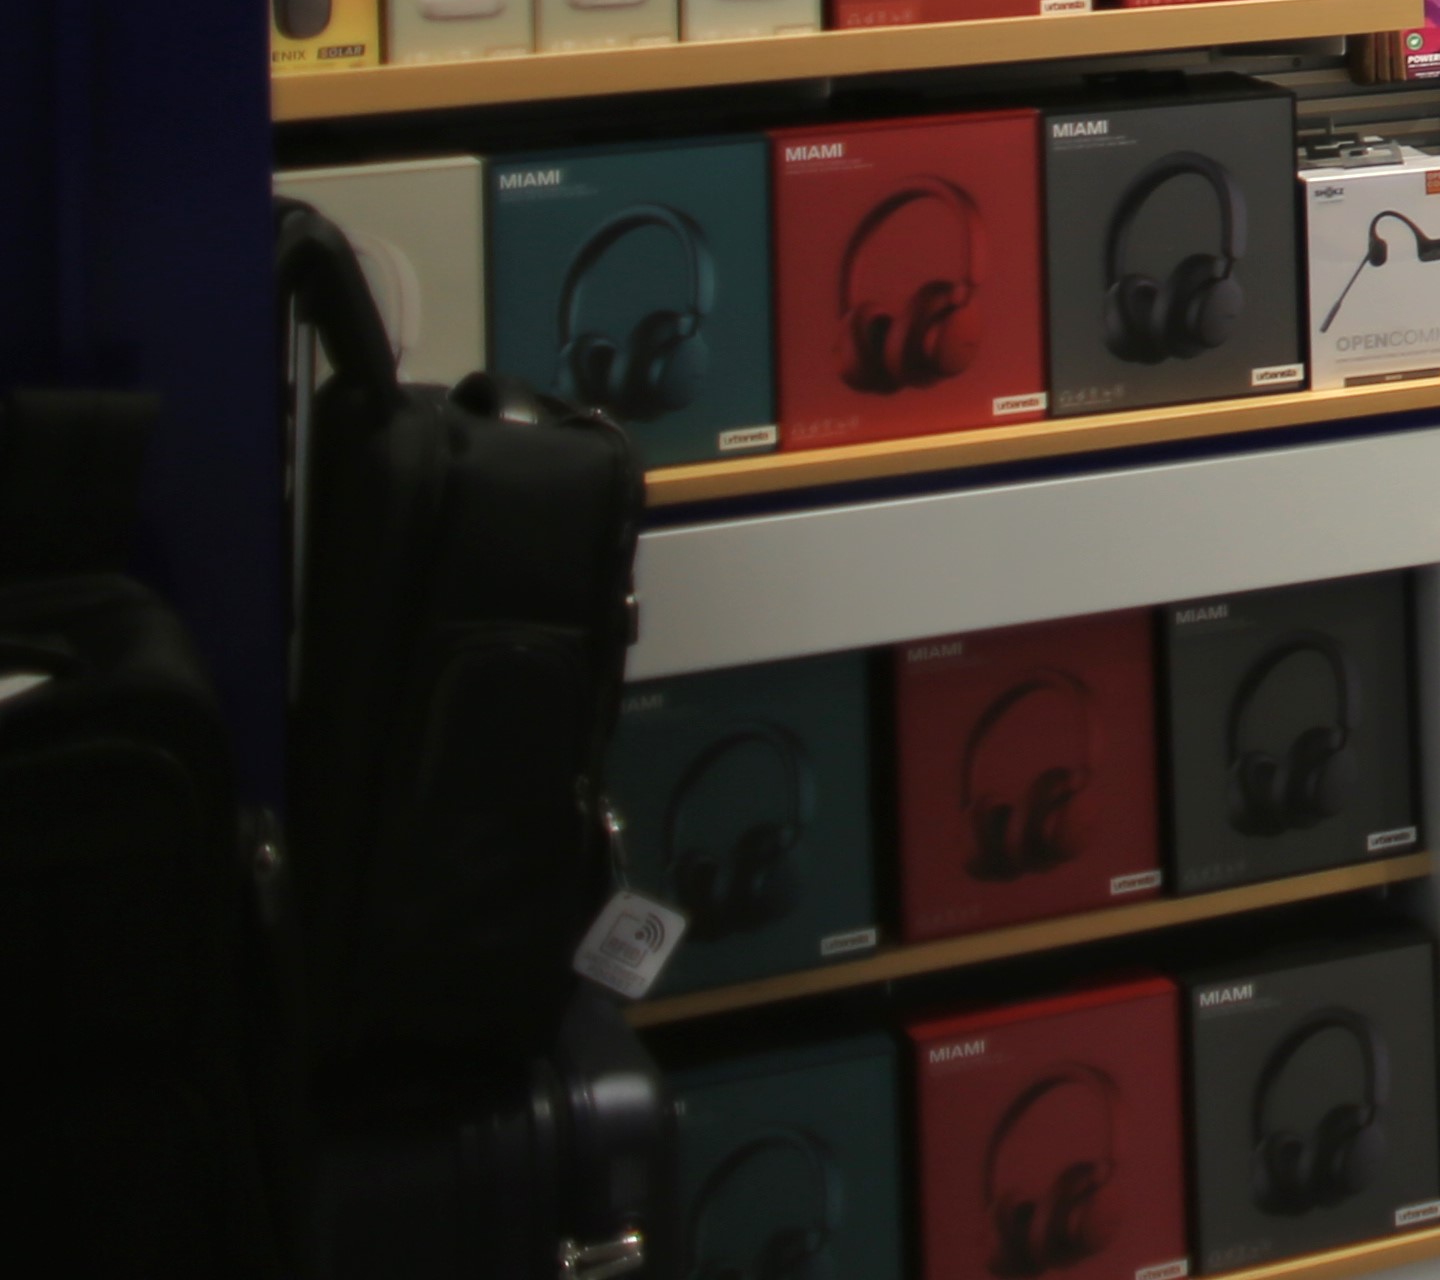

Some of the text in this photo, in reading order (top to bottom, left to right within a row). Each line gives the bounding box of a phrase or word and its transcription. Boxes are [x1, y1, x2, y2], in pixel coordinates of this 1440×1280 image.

[1052, 119, 1110, 139] MIAMI
[500, 169, 560, 190] MIAMI
[1201, 981, 1254, 1008] MIAMI
